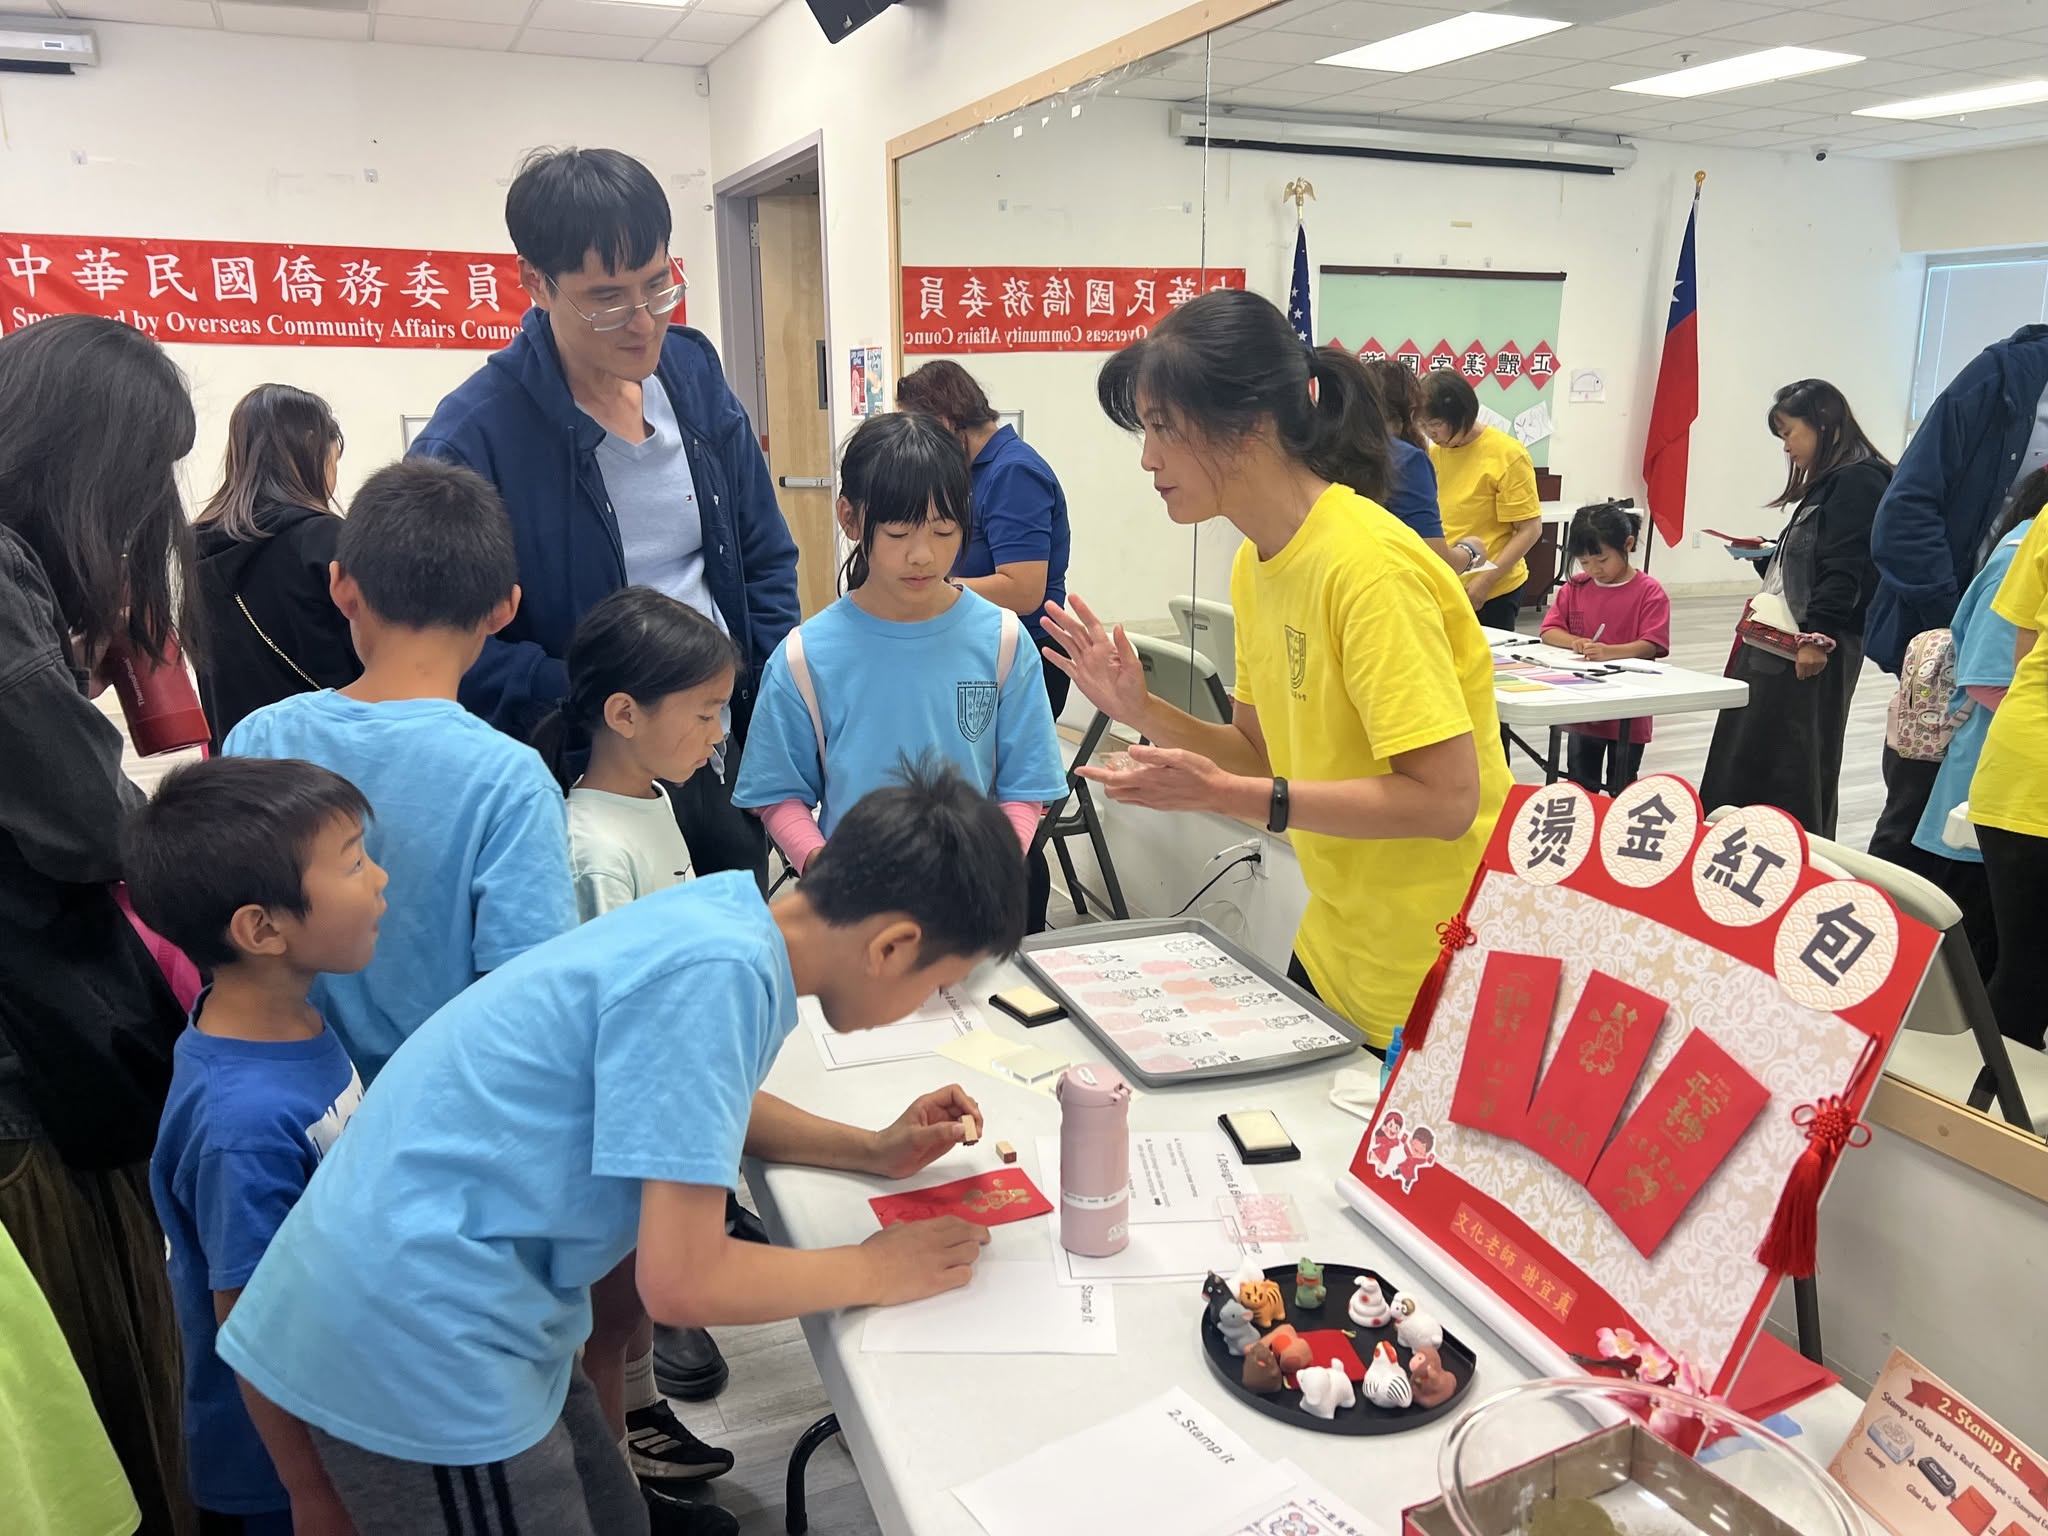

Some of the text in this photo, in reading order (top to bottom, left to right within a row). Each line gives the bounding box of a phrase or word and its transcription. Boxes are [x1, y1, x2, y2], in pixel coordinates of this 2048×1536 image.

[6, 243, 523, 313] 中華民國僑務委員
[132, 309, 160, 337] by
[166, 311, 261, 335] Overseas
[266, 314, 385, 343] Community
[390, 318, 456, 339] Affairs
[460, 319, 524, 340] Counc
[1526, 793, 1876, 987] 燙金紅包
[1454, 1210, 1518, 1270] 文化老師
[1080, 1284, 1095, 1314] Stamp
[1166, 1408, 1236, 1465] 2. Stamp it
[1881, 1391, 1908, 1418] Stamp
[1914, 1418, 1935, 1438] Glue
[1934, 1433, 1954, 1453] Pad
[1937, 1396, 2023, 1472] 2. Stamp It
